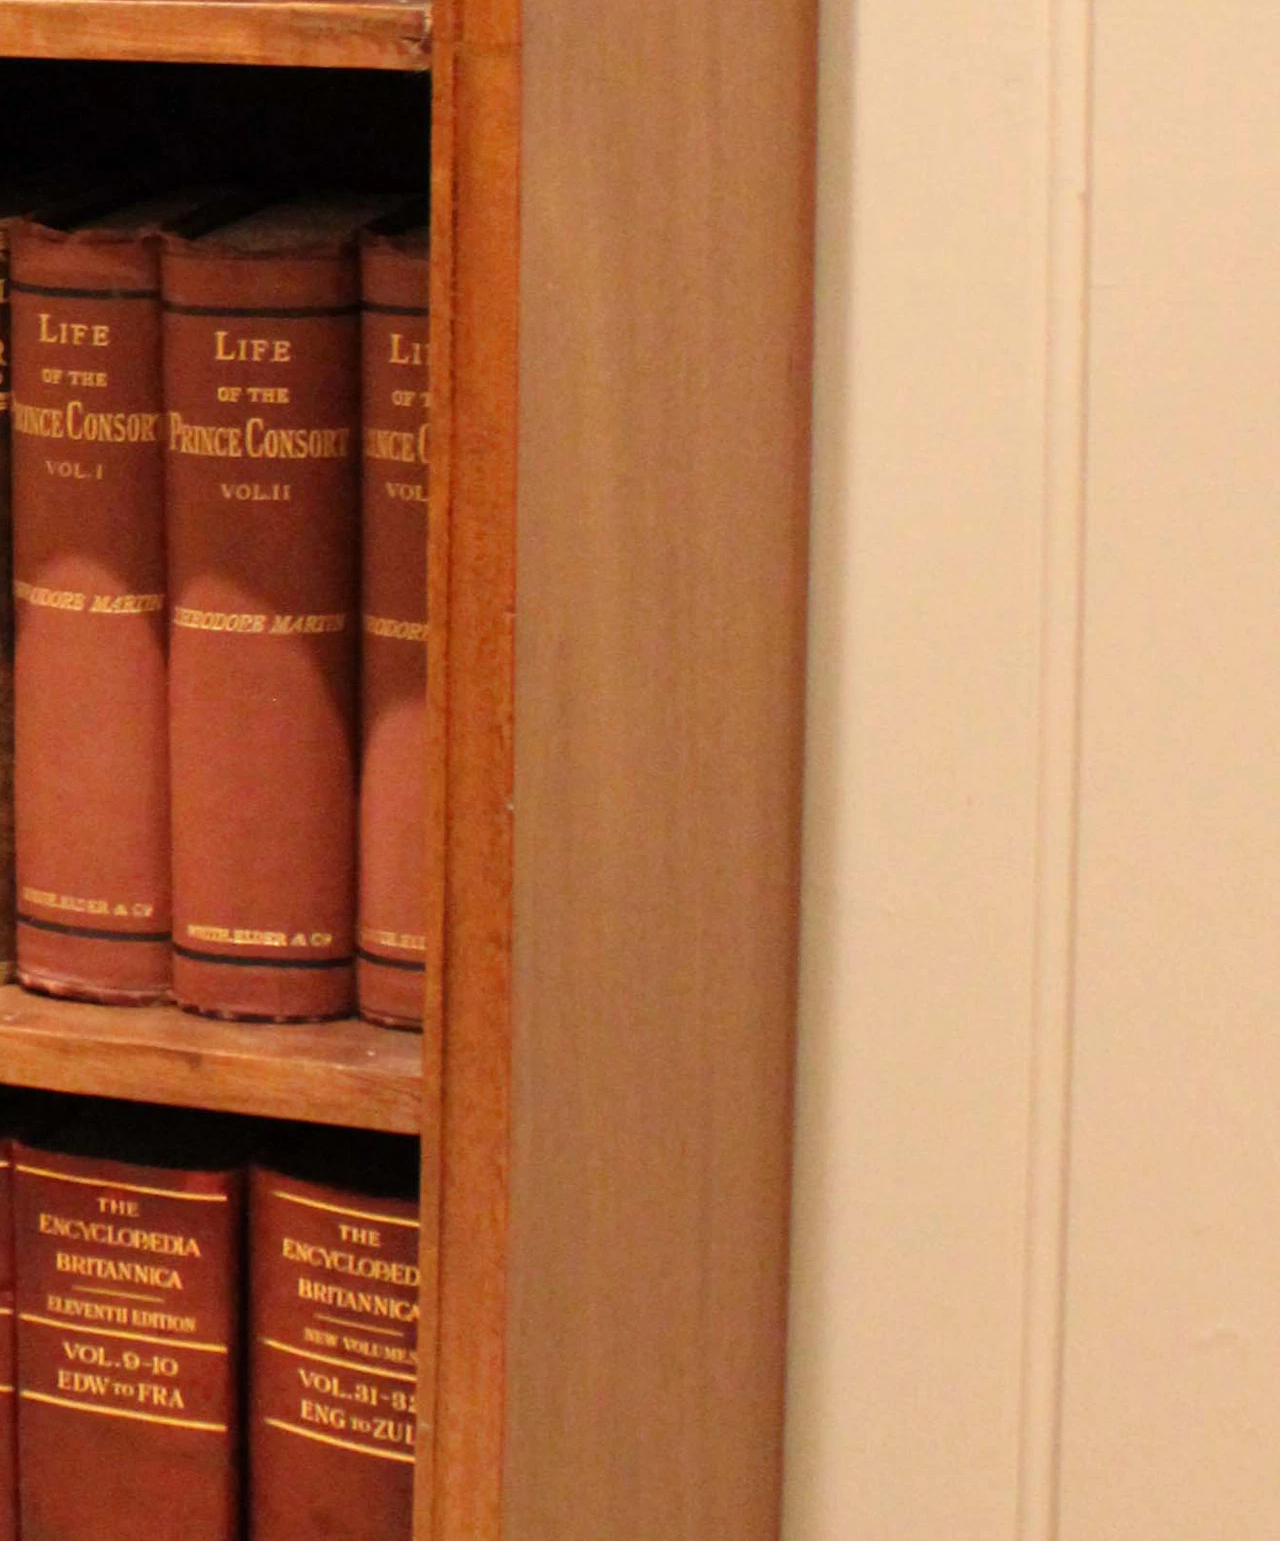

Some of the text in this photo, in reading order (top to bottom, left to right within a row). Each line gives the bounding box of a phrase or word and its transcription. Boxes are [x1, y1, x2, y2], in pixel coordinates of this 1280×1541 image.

[39, 313, 110, 347] LIFE
[214, 330, 291, 363] LIFE
[389, 334, 429, 365] LI
[41, 370, 108, 388] OF THE
[217, 387, 290, 405] OF THE
[392, 390, 416, 408] OF
[169, 410, 350, 460] PRINCE CONSORT
[97, 1197, 139, 1217] THE
[39, 1213, 202, 1258] ENCYCLOPÆDIA
[338, 1224, 381, 1248] THE
[56, 1252, 184, 1291] BRITANNICA
[282, 1238, 419, 1288] ENCYCLOPÆD
[47, 1295, 197, 1333] ELEVENTH EDITION
[303, 1326, 338, 1348] NEW
[62, 1341, 179, 1378] VOL. 9-10
[58, 1370, 110, 1395] EDW
[138, 1382, 185, 1409] FRA
[301, 1398, 345, 1429] ENG
